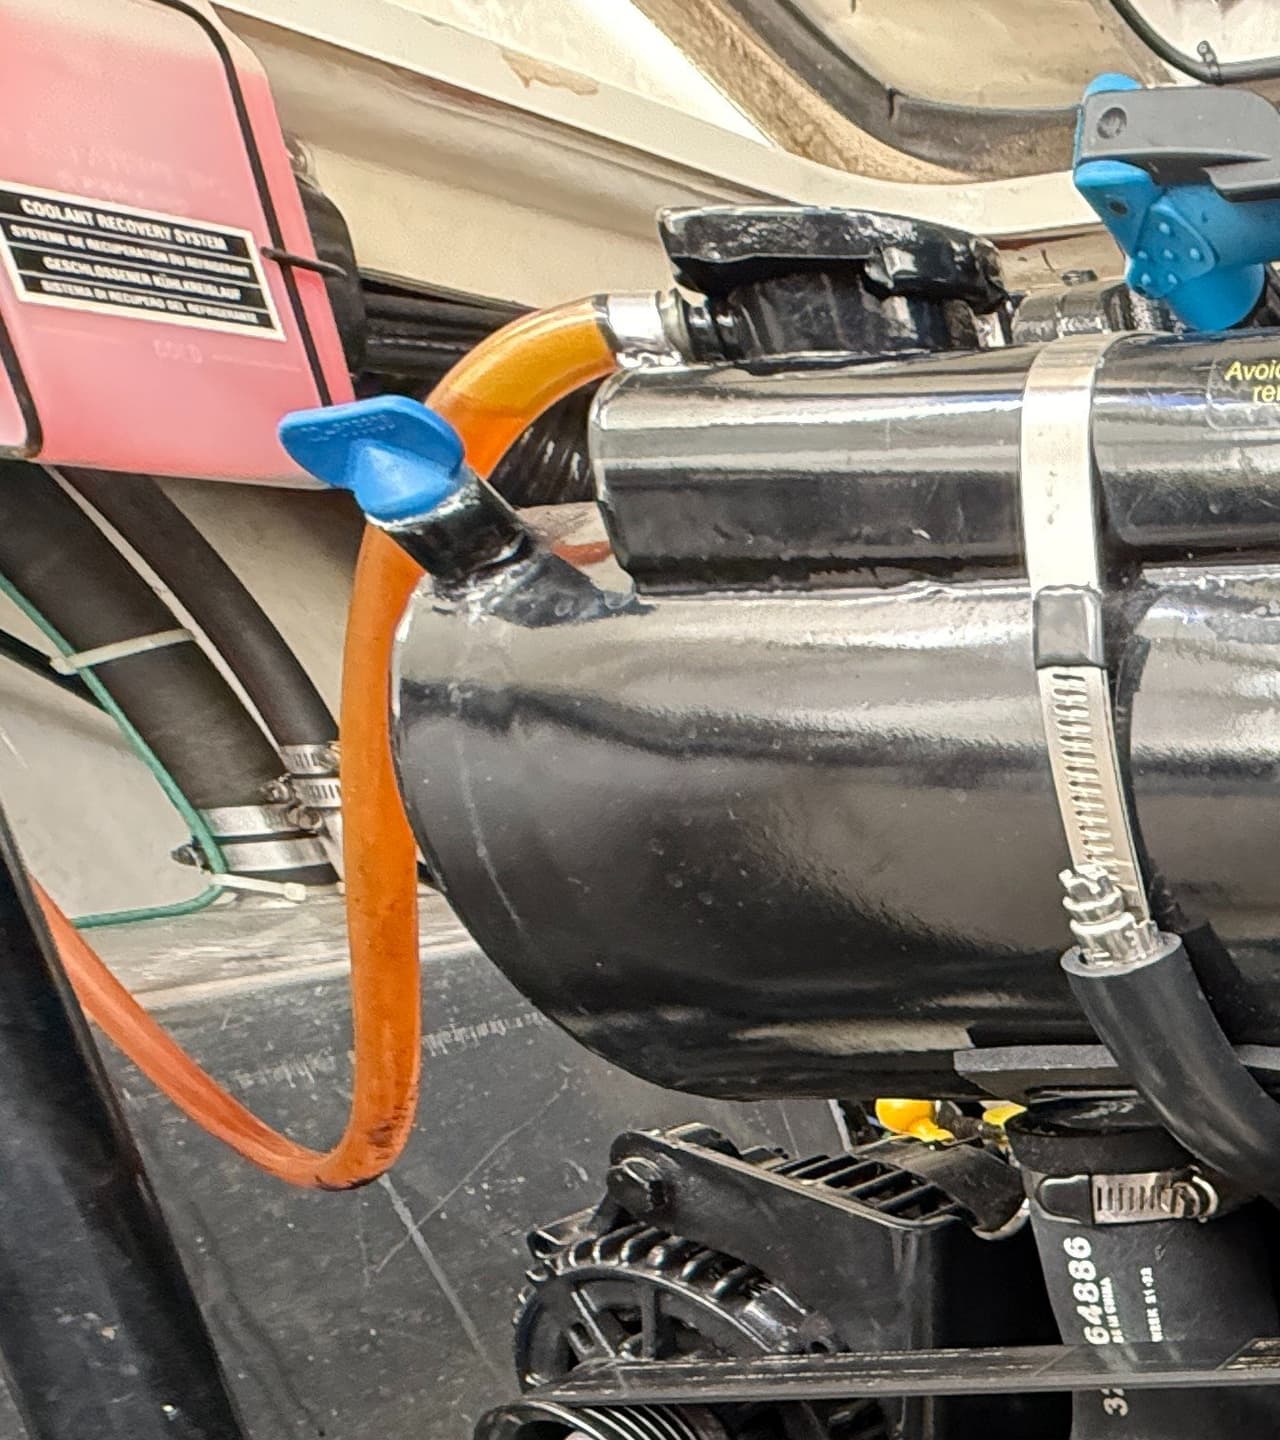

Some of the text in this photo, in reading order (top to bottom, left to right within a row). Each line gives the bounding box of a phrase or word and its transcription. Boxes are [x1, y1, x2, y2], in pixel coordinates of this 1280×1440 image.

[20, 198, 229, 252] COOLANT RECOVERY SYSTEM
